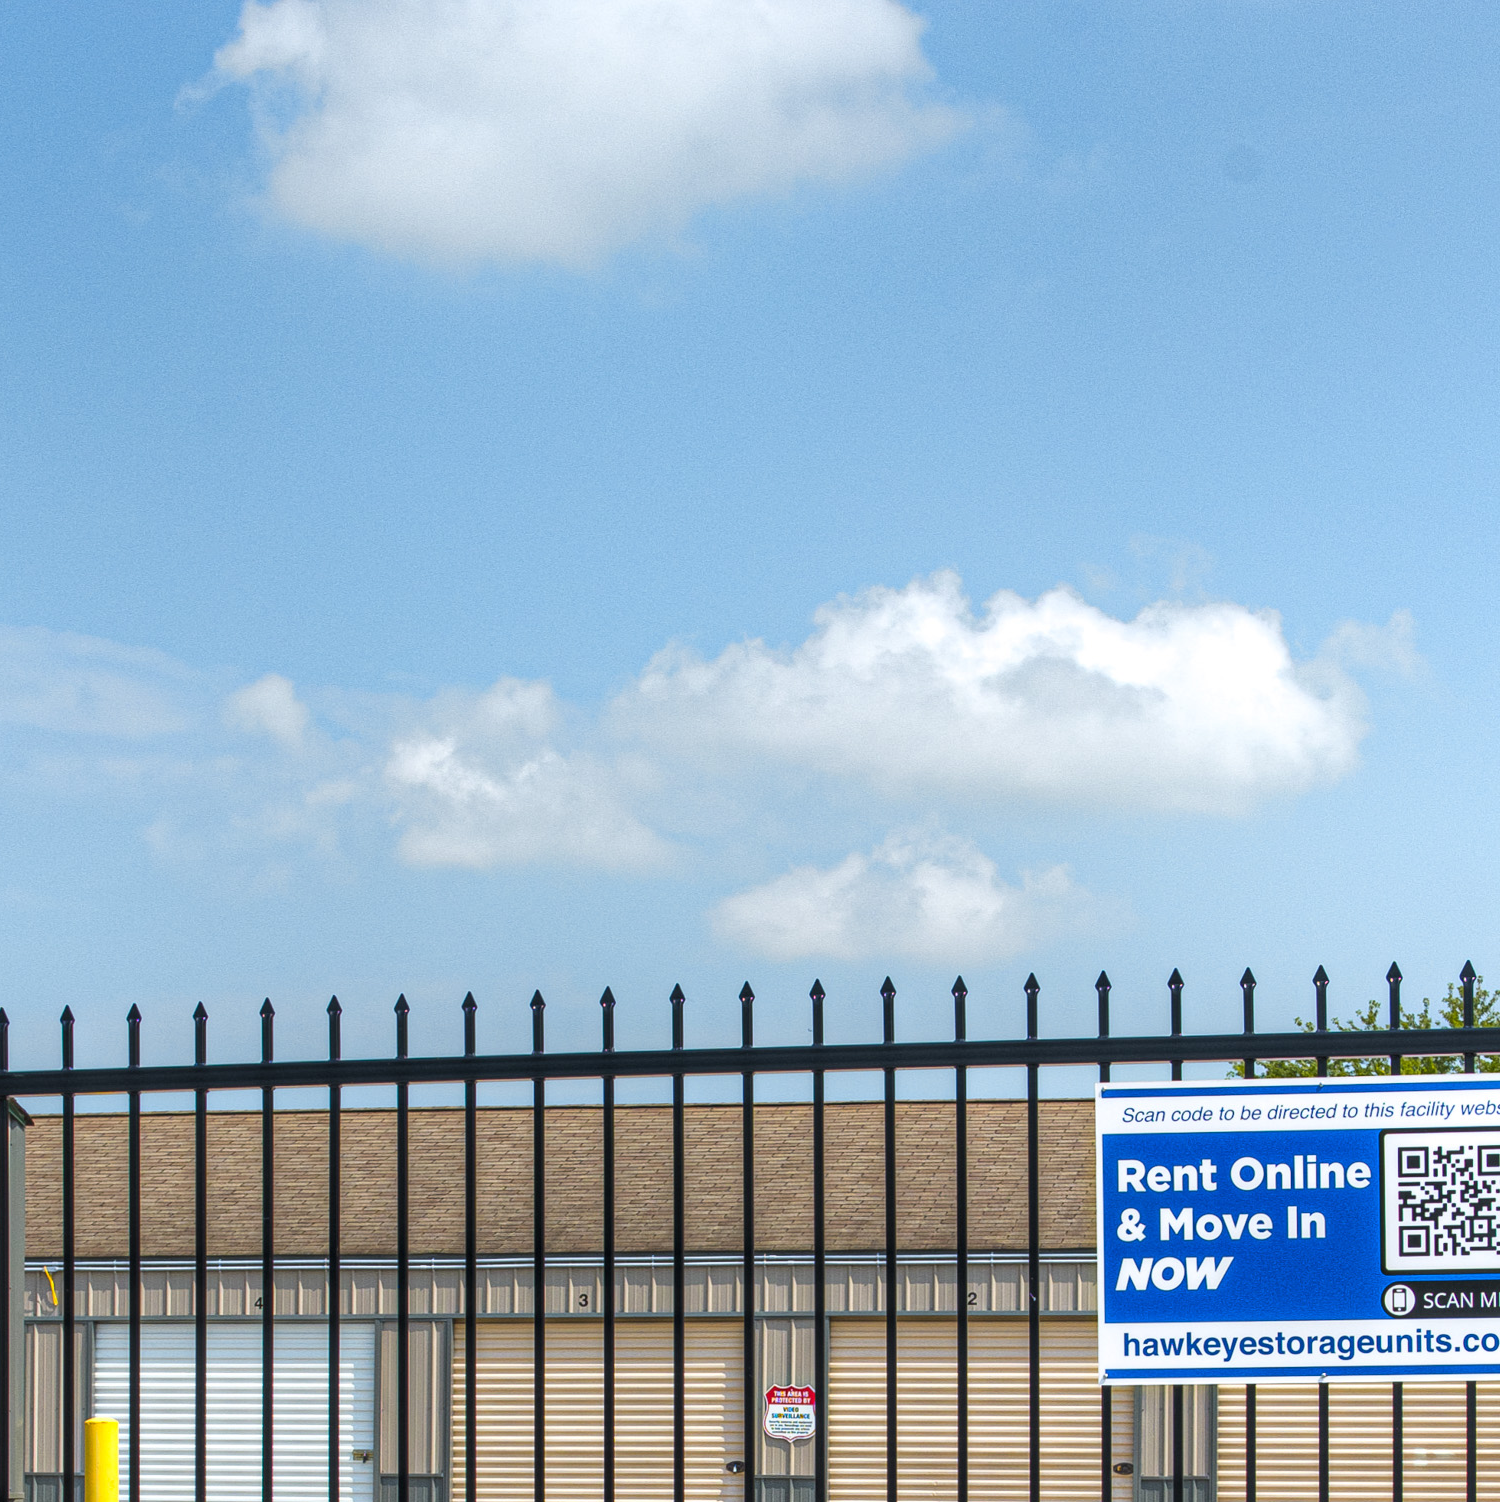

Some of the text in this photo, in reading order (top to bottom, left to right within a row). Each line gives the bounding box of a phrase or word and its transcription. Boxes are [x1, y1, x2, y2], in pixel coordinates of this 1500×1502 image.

[1122, 1106, 1166, 1123] Scan
[1170, 1106, 1213, 1122] code
[1219, 1106, 1235, 1121] to
[1240, 1105, 1262, 1121] be
[1267, 1103, 1338, 1120] directed
[1342, 1104, 1359, 1119] to
[1364, 1102, 1395, 1118] this
[1400, 1101, 1456, 1120] facility
[1117, 1155, 1372, 1192] Rent Online
[1116, 1205, 1327, 1242] & Move In
[1115, 1256, 1235, 1292] NOW
[254, 1297, 263, 1309] 4
[578, 1293, 589, 1307] 3
[968, 1292, 977, 1305] 2
[1423, 1292, 1474, 1309] SCAN
